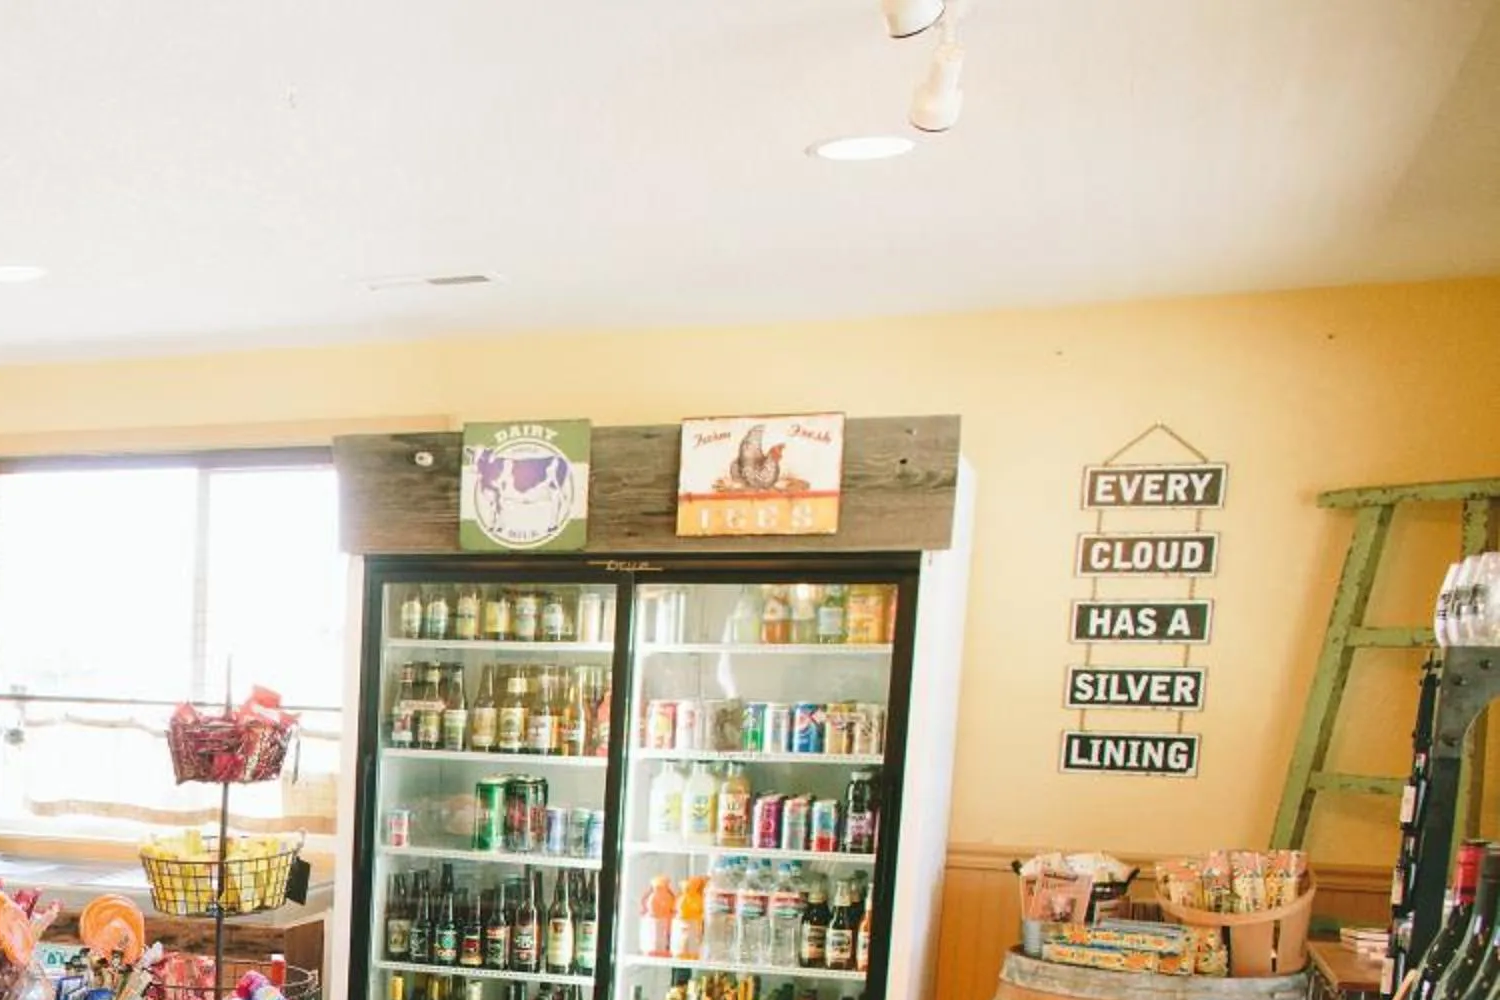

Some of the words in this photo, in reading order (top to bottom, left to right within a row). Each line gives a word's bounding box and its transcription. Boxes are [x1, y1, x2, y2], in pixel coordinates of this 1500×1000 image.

[494, 424, 558, 442] DAIRY
[1094, 473, 1213, 502] EVERY
[1089, 541, 1205, 570] CLOUD
[1088, 607, 1157, 637] HAS
[1166, 607, 1192, 637] A
[1073, 672, 1196, 703] SILVER
[1068, 738, 1190, 770] LINING
